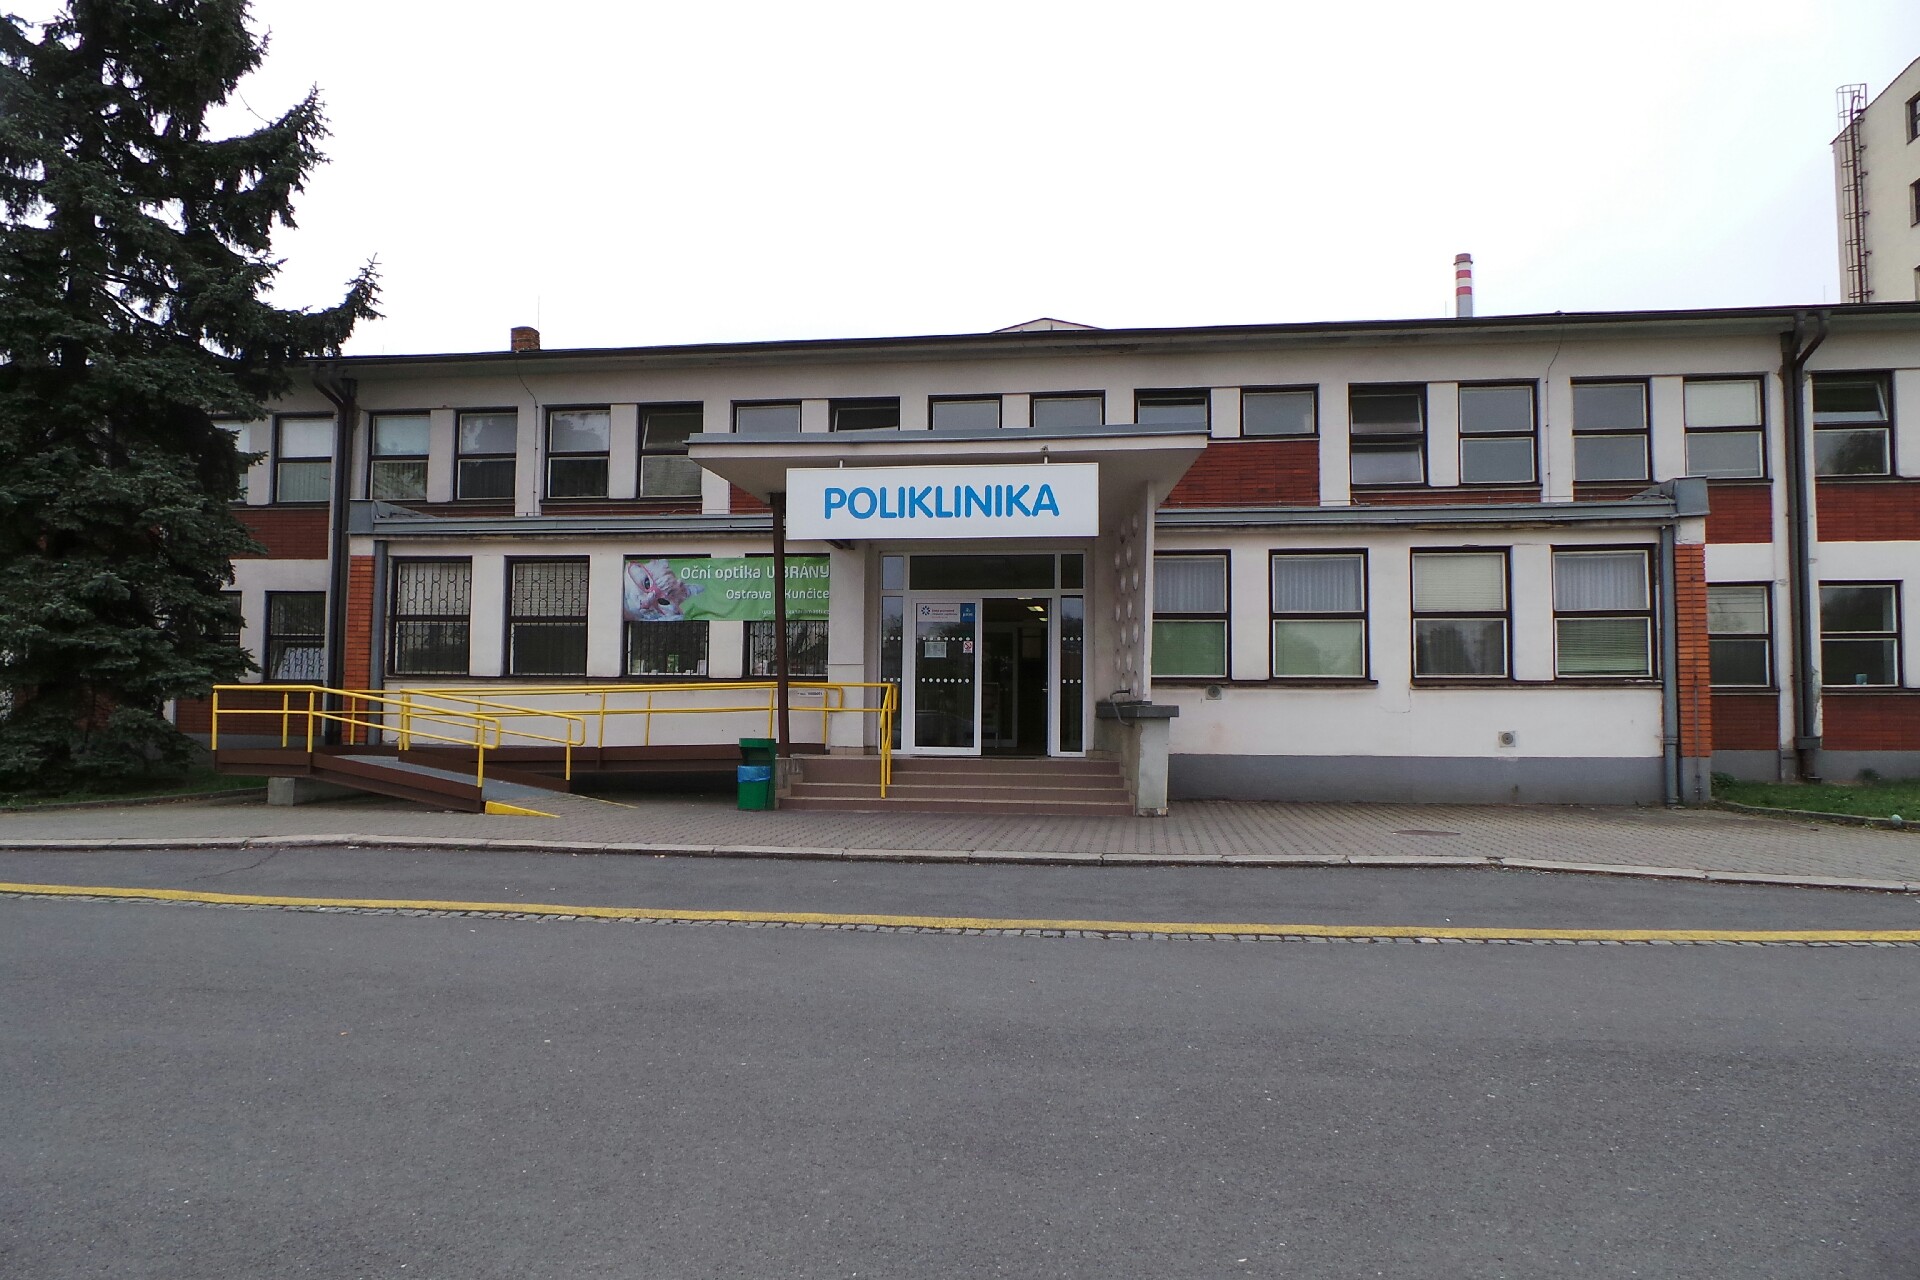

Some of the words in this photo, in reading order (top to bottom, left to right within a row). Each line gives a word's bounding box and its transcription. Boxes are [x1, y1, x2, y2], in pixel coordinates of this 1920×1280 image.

[824, 483, 1060, 519] POLIKLINIKA
[680, 564, 711, 579] Oční
[715, 565, 761, 581] optika
[766, 565, 775, 579] U
[726, 589, 772, 599] Ostrava
[785, 587, 830, 599] Kunčice
